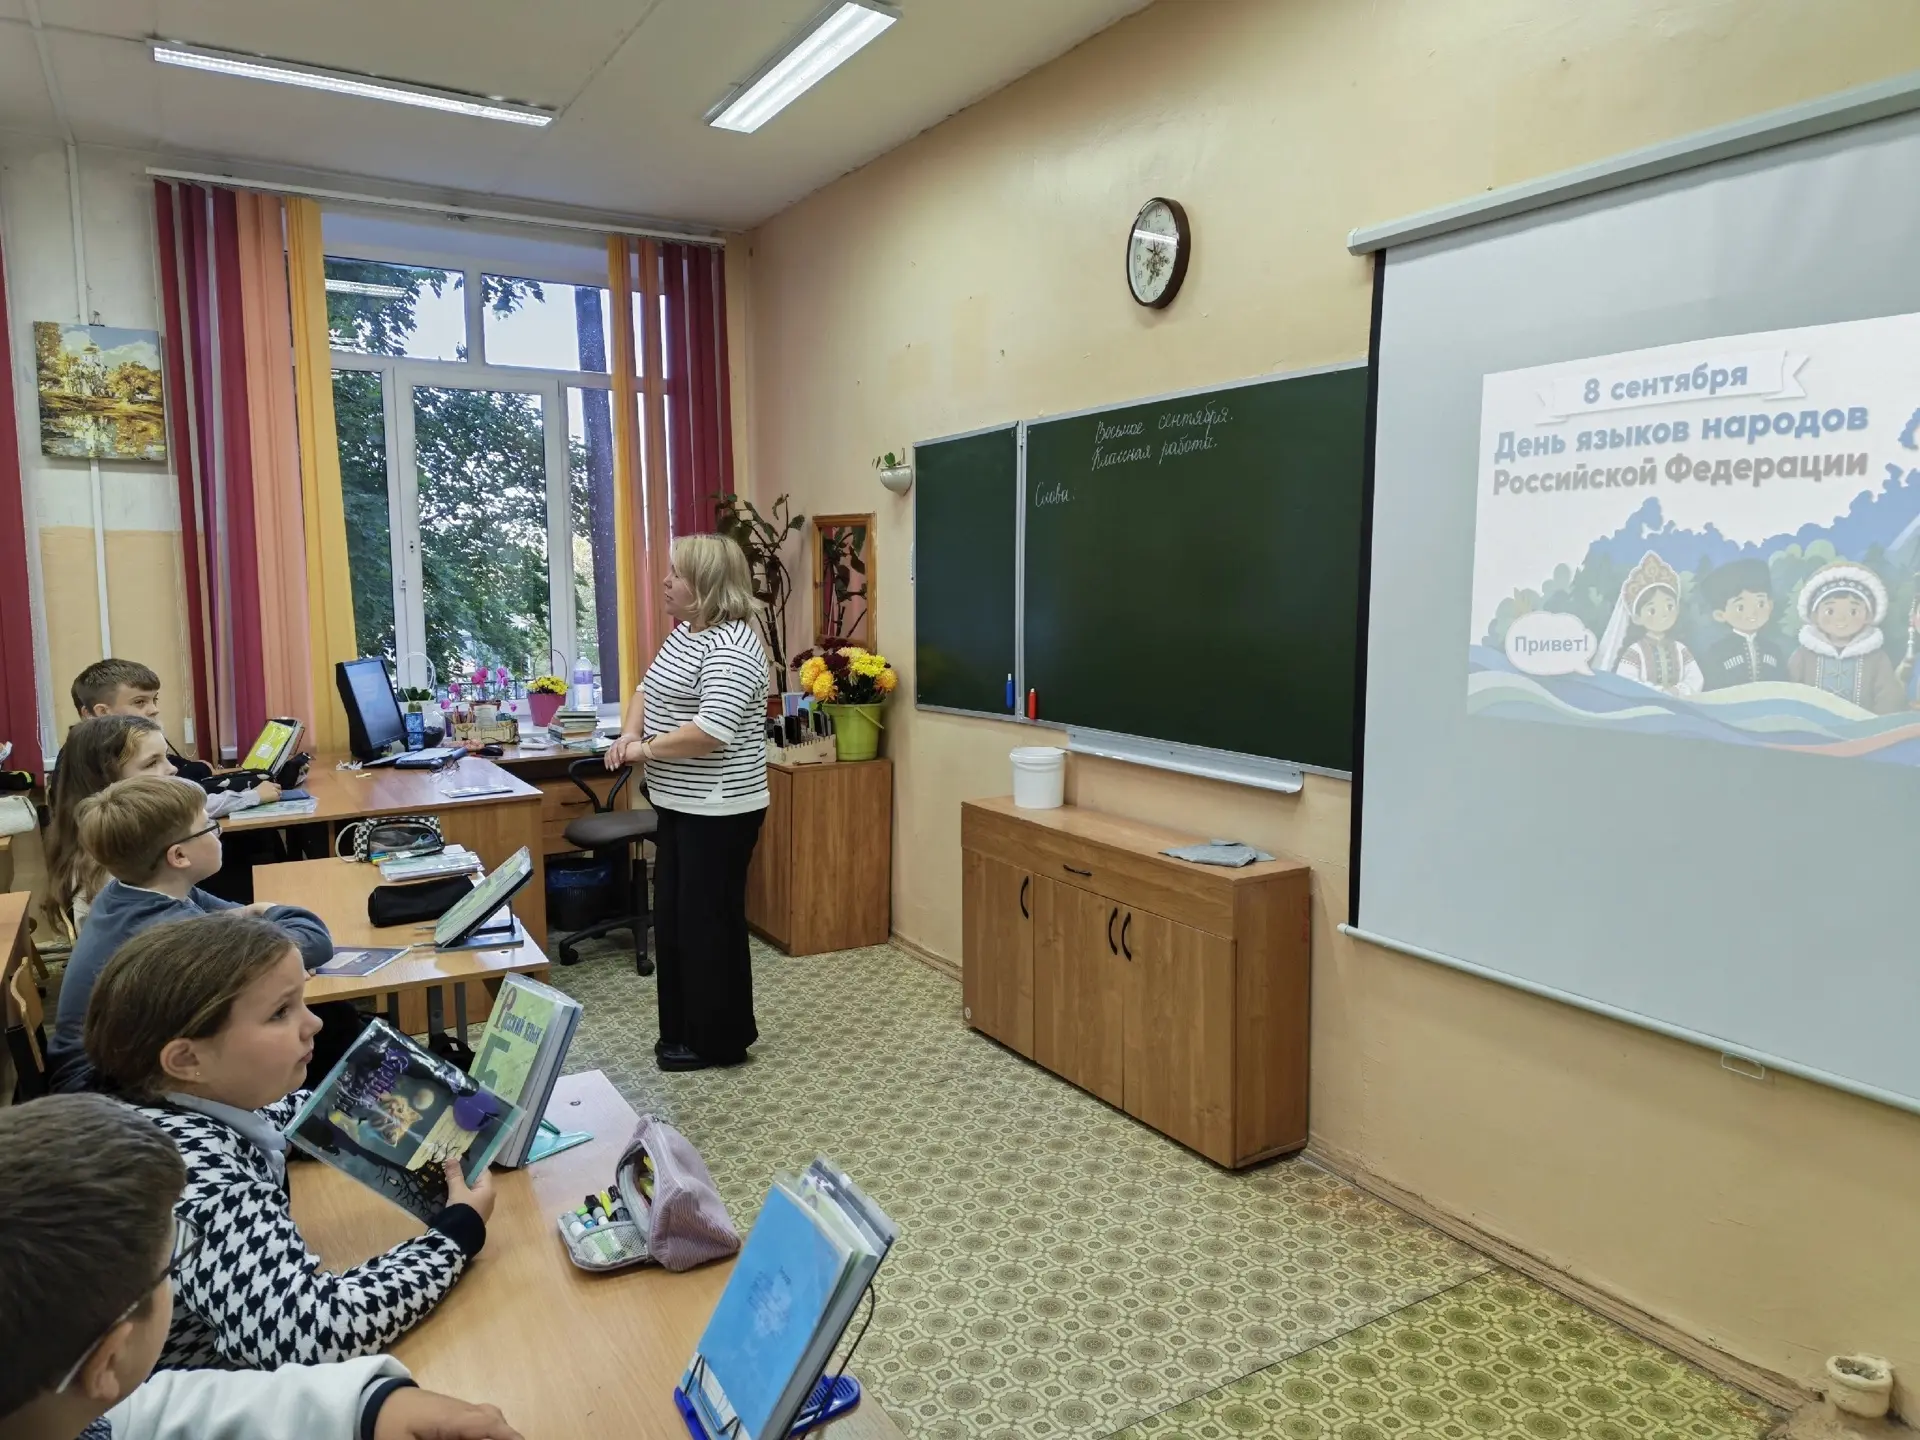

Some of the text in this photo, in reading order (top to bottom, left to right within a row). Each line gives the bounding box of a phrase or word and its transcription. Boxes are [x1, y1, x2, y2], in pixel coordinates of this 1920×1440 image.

[1583, 362, 1749, 404] 8 сентября
[1095, 421, 1145, 444] Восьмое
[1494, 406, 1869, 465] День языков народов
[1091, 445, 1151, 471] Классная
[1493, 452, 1869, 495] Российской Федерации
[1513, 634, 1590, 655] Привет!
